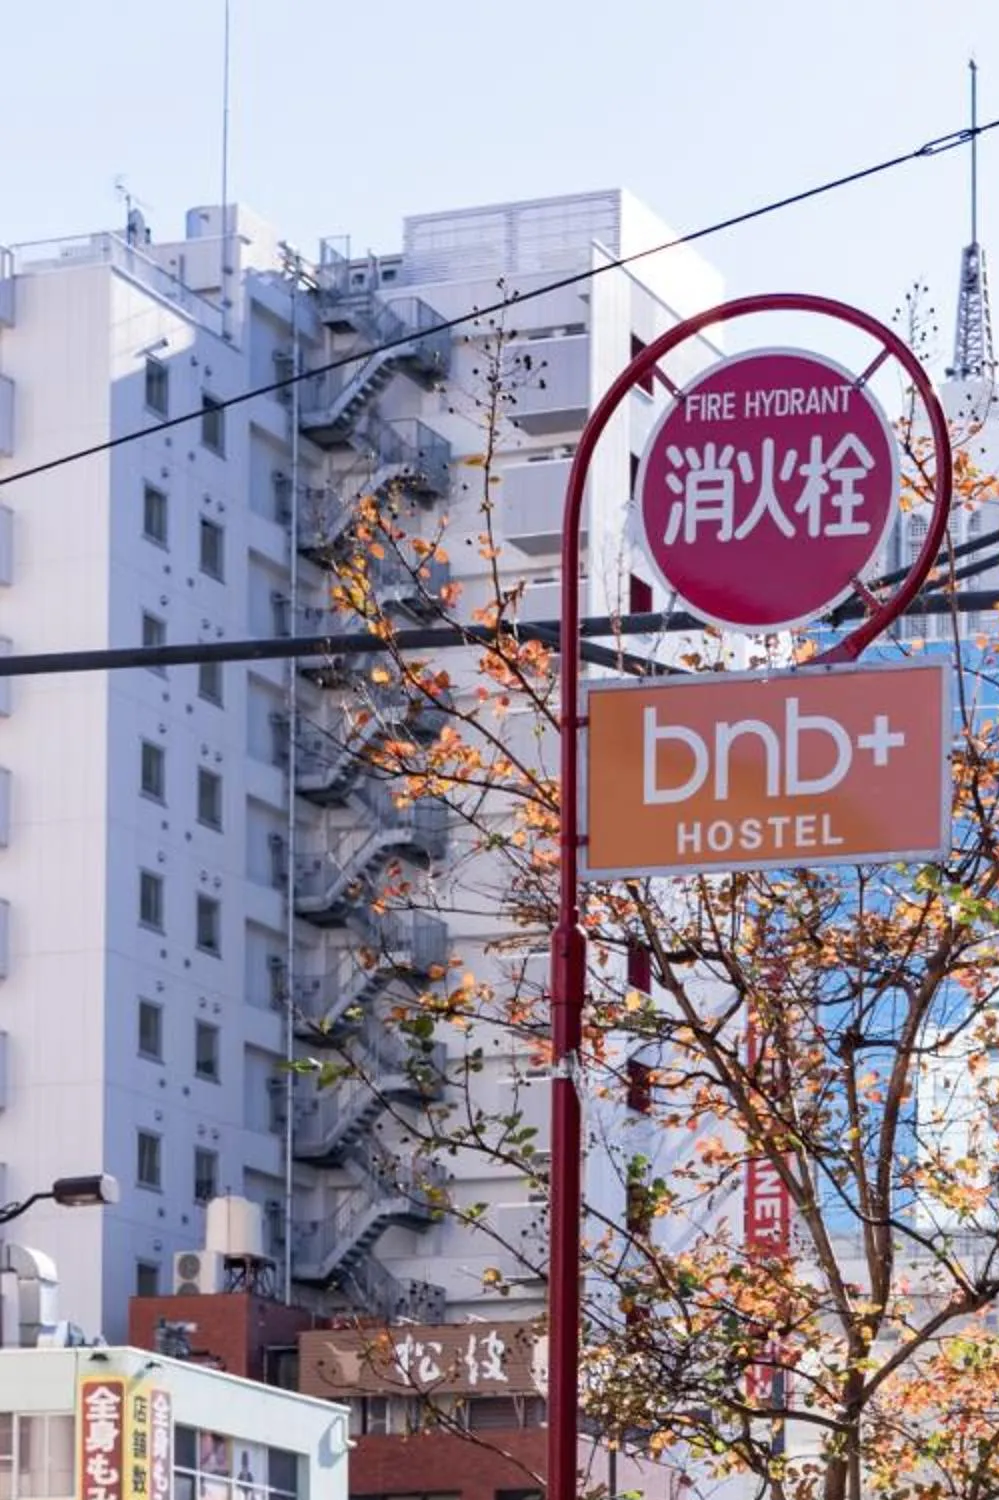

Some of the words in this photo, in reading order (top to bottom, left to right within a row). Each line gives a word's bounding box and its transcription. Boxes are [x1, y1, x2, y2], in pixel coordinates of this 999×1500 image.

[684, 391, 736, 422] FIRE
[744, 384, 852, 418] HYDRANT
[664, 433, 875, 545] 消火栓
[643, 697, 904, 805] bnb+
[676, 814, 844, 854] HOSTEL
